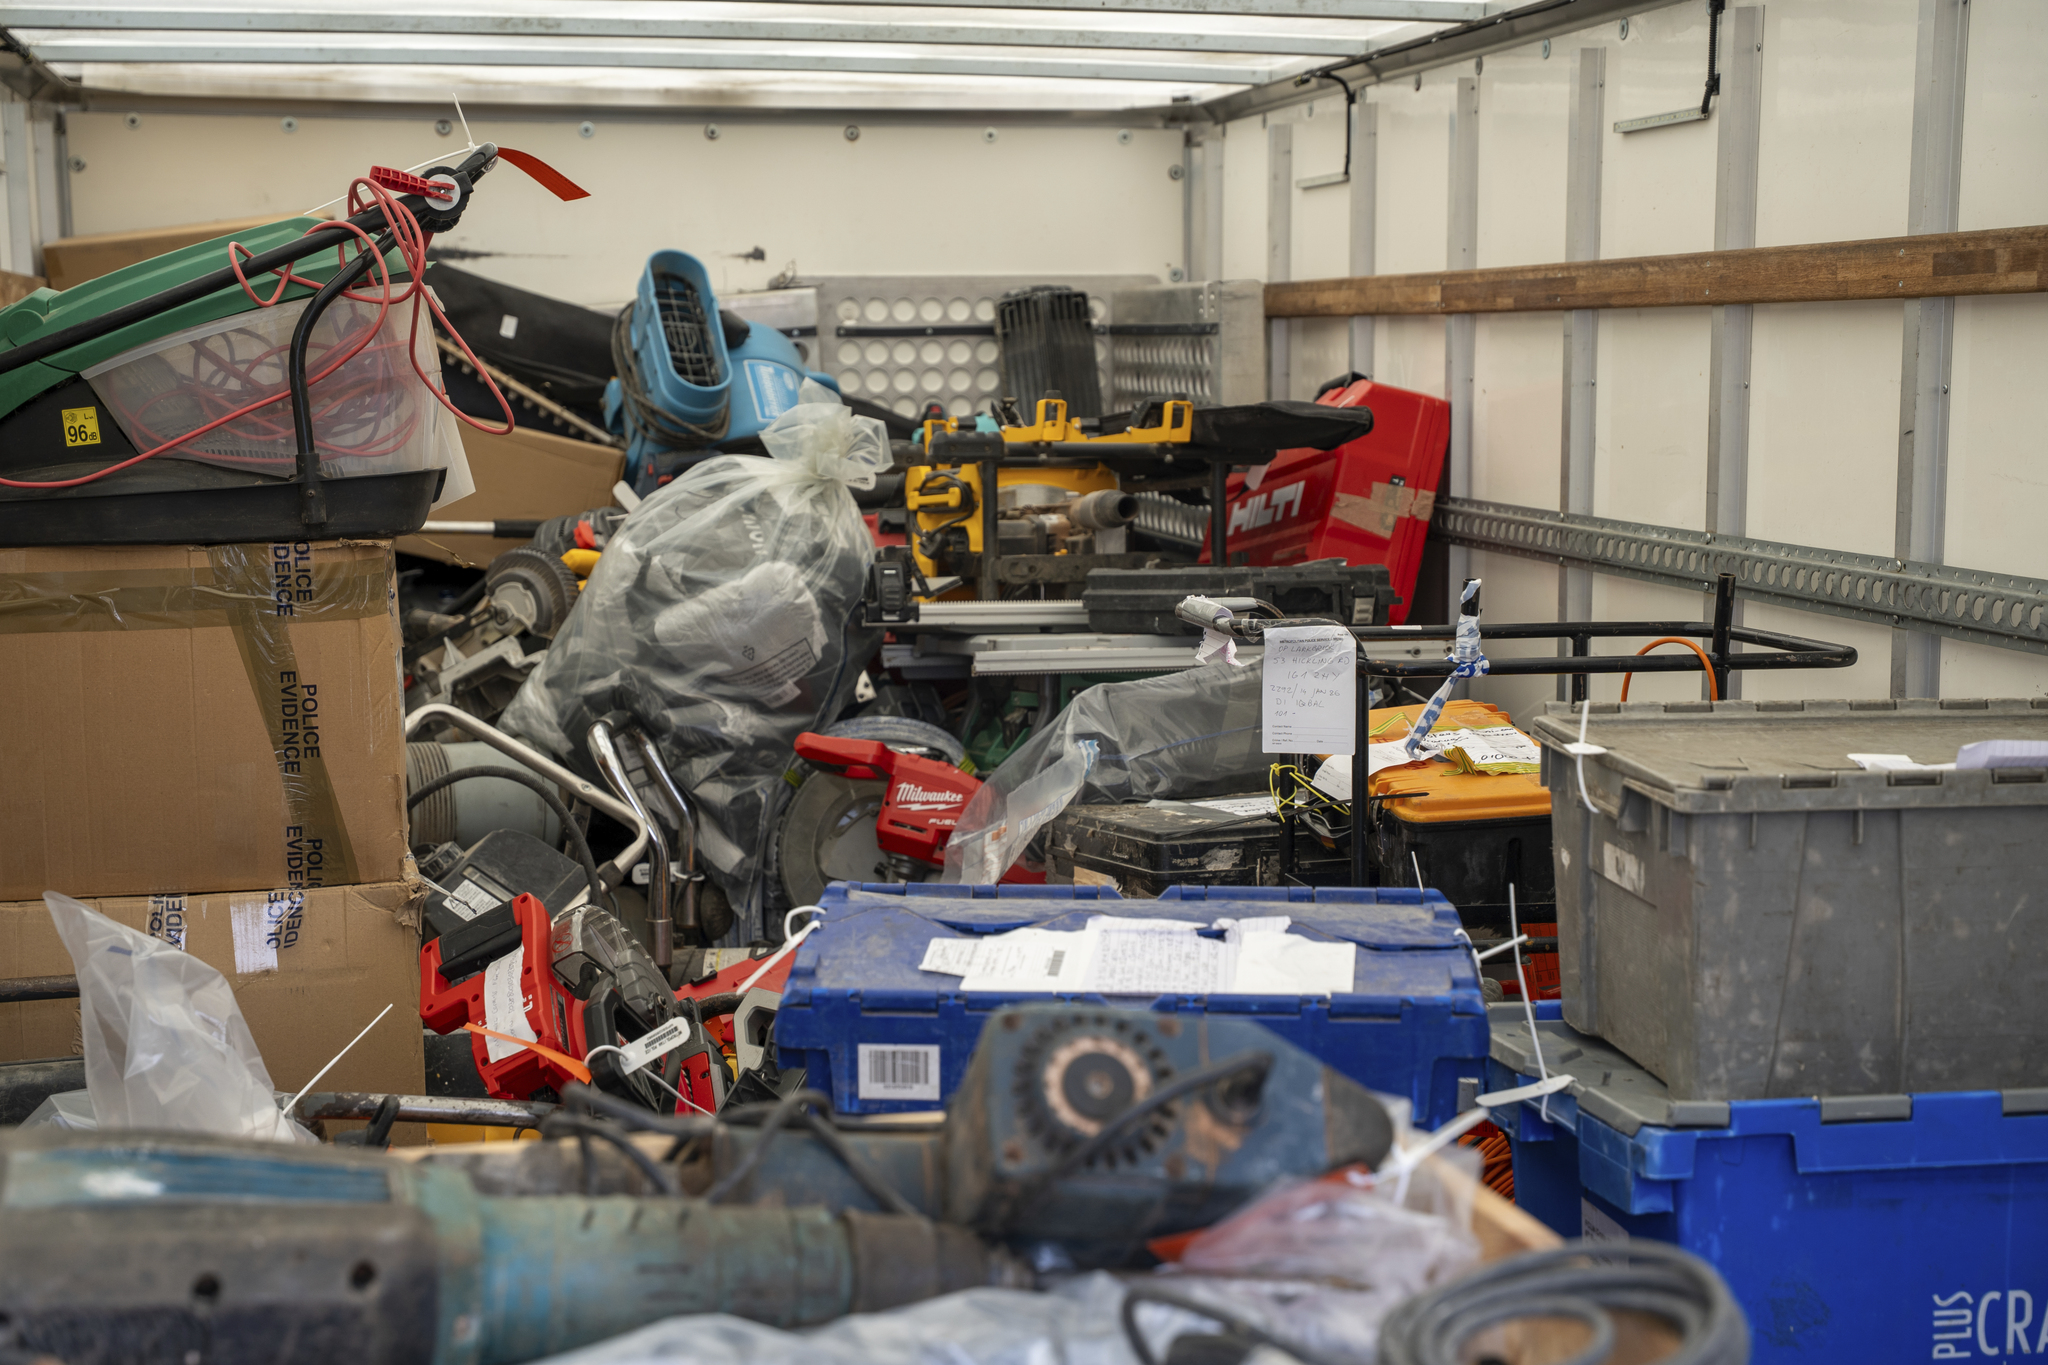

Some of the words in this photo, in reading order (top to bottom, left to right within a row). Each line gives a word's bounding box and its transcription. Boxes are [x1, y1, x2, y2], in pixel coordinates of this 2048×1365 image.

[67, 424, 88, 443] 96
[88, 431, 97, 441] dB
[1227, 479, 1306, 537] HILTI
[273, 541, 293, 617] IDENCE
[293, 541, 312, 602] OLICE
[1337, 657, 1350, 665] RD
[301, 684, 320, 758] POLICE
[1311, 688, 1326, 698] JAN
[280, 671, 301, 773] EVIDENCE
[897, 782, 963, 803] Milwaukee
[928, 818, 958, 826] FUEL
[286, 826, 304, 890] EVIDEN
[307, 839, 323, 888] POLI
[149, 895, 164, 937] OLI
[266, 892, 284, 949] OLICE
[283, 891, 305, 949] IDENC
[1932, 1290, 1974, 1360] PLUS
